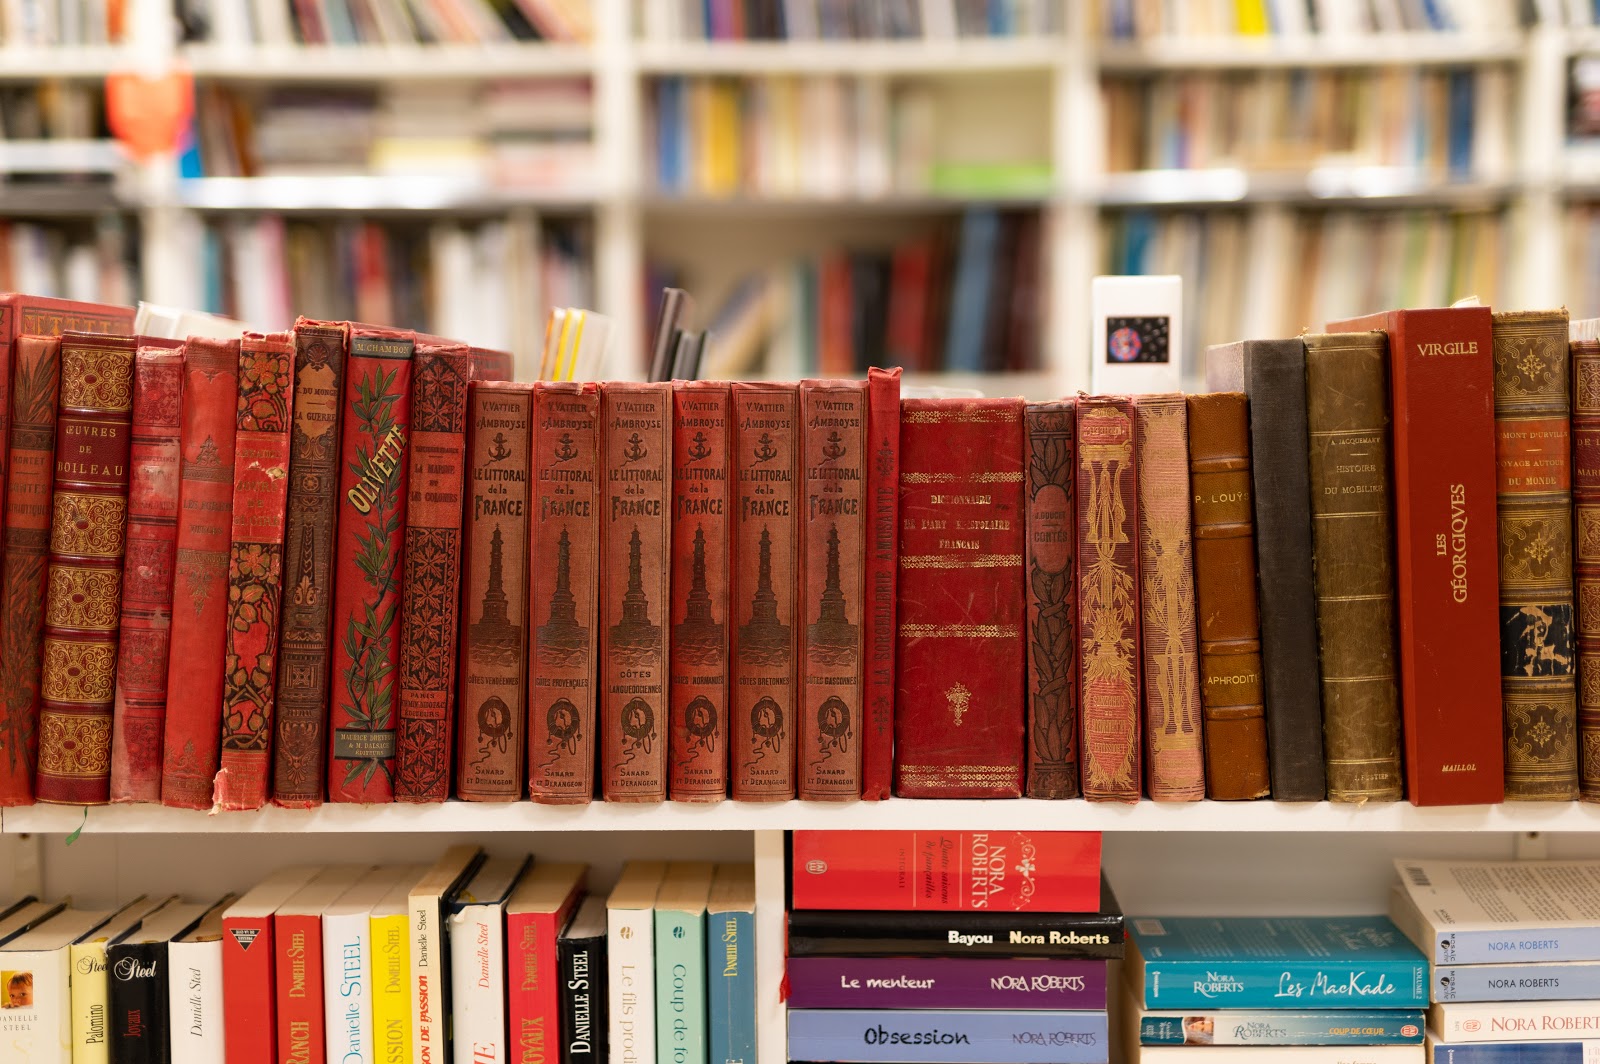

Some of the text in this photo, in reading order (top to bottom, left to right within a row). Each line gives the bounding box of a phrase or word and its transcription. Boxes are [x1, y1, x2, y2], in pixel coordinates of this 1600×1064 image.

[1417, 342, 1478, 356] VIRGILE
[66, 425, 117, 438] ŒUVRES
[79, 445, 92, 454] DE
[57, 461, 123, 476] BOILEAU
[347, 424, 407, 513] OLIVETTE
[473, 468, 526, 482] LE LITTORAL
[539, 468, 593, 482] LE LITTORAL
[609, 468, 663, 482] LE LITTORAL
[684, 468, 726, 481] LITTORAL
[739, 469, 792, 482] LE LITTORAL
[808, 468, 861, 481] LE LITTORAL
[1336, 464, 1377, 473] HISTOIRE
[487, 483, 508, 495] de la
[624, 483, 645, 495] de la
[688, 482, 709, 494] de la
[823, 482, 843, 494] de la
[1508, 476, 1557, 486] DU MONDE
[554, 484, 575, 495] de la
[754, 484, 775, 495] de la
[1324, 485, 1384, 495] DU MOBILIER
[931, 494, 992, 505] DICIONNAIRE
[1195, 495, 1205, 504] P.
[474, 495, 523, 522] FRANCE
[541, 496, 590, 523] FRANCE
[611, 495, 661, 523] FRANCE
[677, 495, 723, 522] FRANCE
[742, 496, 790, 523] FRANCE
[809, 494, 858, 522] FRANCE
[1436, 533, 1448, 556] LES
[1450, 483, 1468, 603] GÉORGIQVES
[620, 669, 652, 679] CÔTES
[874, 668, 891, 687] LA
[1207, 674, 1258, 685] APHRODIT
[475, 765, 505, 775] SANARD
[619, 767, 650, 777] SANARD
[683, 765, 713, 776] SANARD
[750, 766, 780, 776] SANARD
[815, 766, 846, 776] SANARD
[1441, 764, 1477, 772] MAILLOL
[971, 833, 989, 909] ROBERTS
[988, 845, 1007, 896] NORA
[416, 909, 428, 968] Danielle Steel
[948, 930, 1110, 947] Bayou Nora Roberts
[1488, 940, 1559, 951] NORA ROBERTS
[721, 917, 738, 977] DANIELLE STEEL
[287, 929, 306, 998] DANIELLE STEEL
[382, 926, 402, 994] DANIELLE STEEL
[476, 922, 490, 989] Danielle Steel
[519, 921, 539, 991] DANIELLE STEEL
[76, 955, 108, 976] Stee
[114, 956, 157, 982] Steel
[340, 935, 362, 998] STEEL
[621, 965, 636, 987] Le
[841, 974, 1085, 993] Le menteur NORA ROBERTS
[1205, 970, 1235, 983] NORA
[1274, 970, 1397, 998] Les MacKade
[1415, 966, 1423, 994] VOLUME
[1488, 978, 1560, 989] NORA ROBERTS
[669, 964, 687, 1013] Coup
[1193, 980, 1244, 999] ROBERTS
[189, 967, 203, 1038] Danielle Steel
[418, 975, 433, 1042] DE PASSION
[567, 950, 591, 1054] DANIELLE STEEL
[622, 992, 637, 1015] fils
[85, 1004, 104, 1045] Palomino
[123, 1008, 146, 1038] Joyaux
[673, 1018, 688, 1041] de
[1247, 1021, 1271, 1032] NORA
[1329, 1027, 1385, 1035] COUP DE CŒUR
[1491, 1016, 1537, 1032] NORA
[863, 1024, 1097, 1047] Obsession NORA ROBERTS
[1232, 1025, 1287, 1041] ROBERTS
